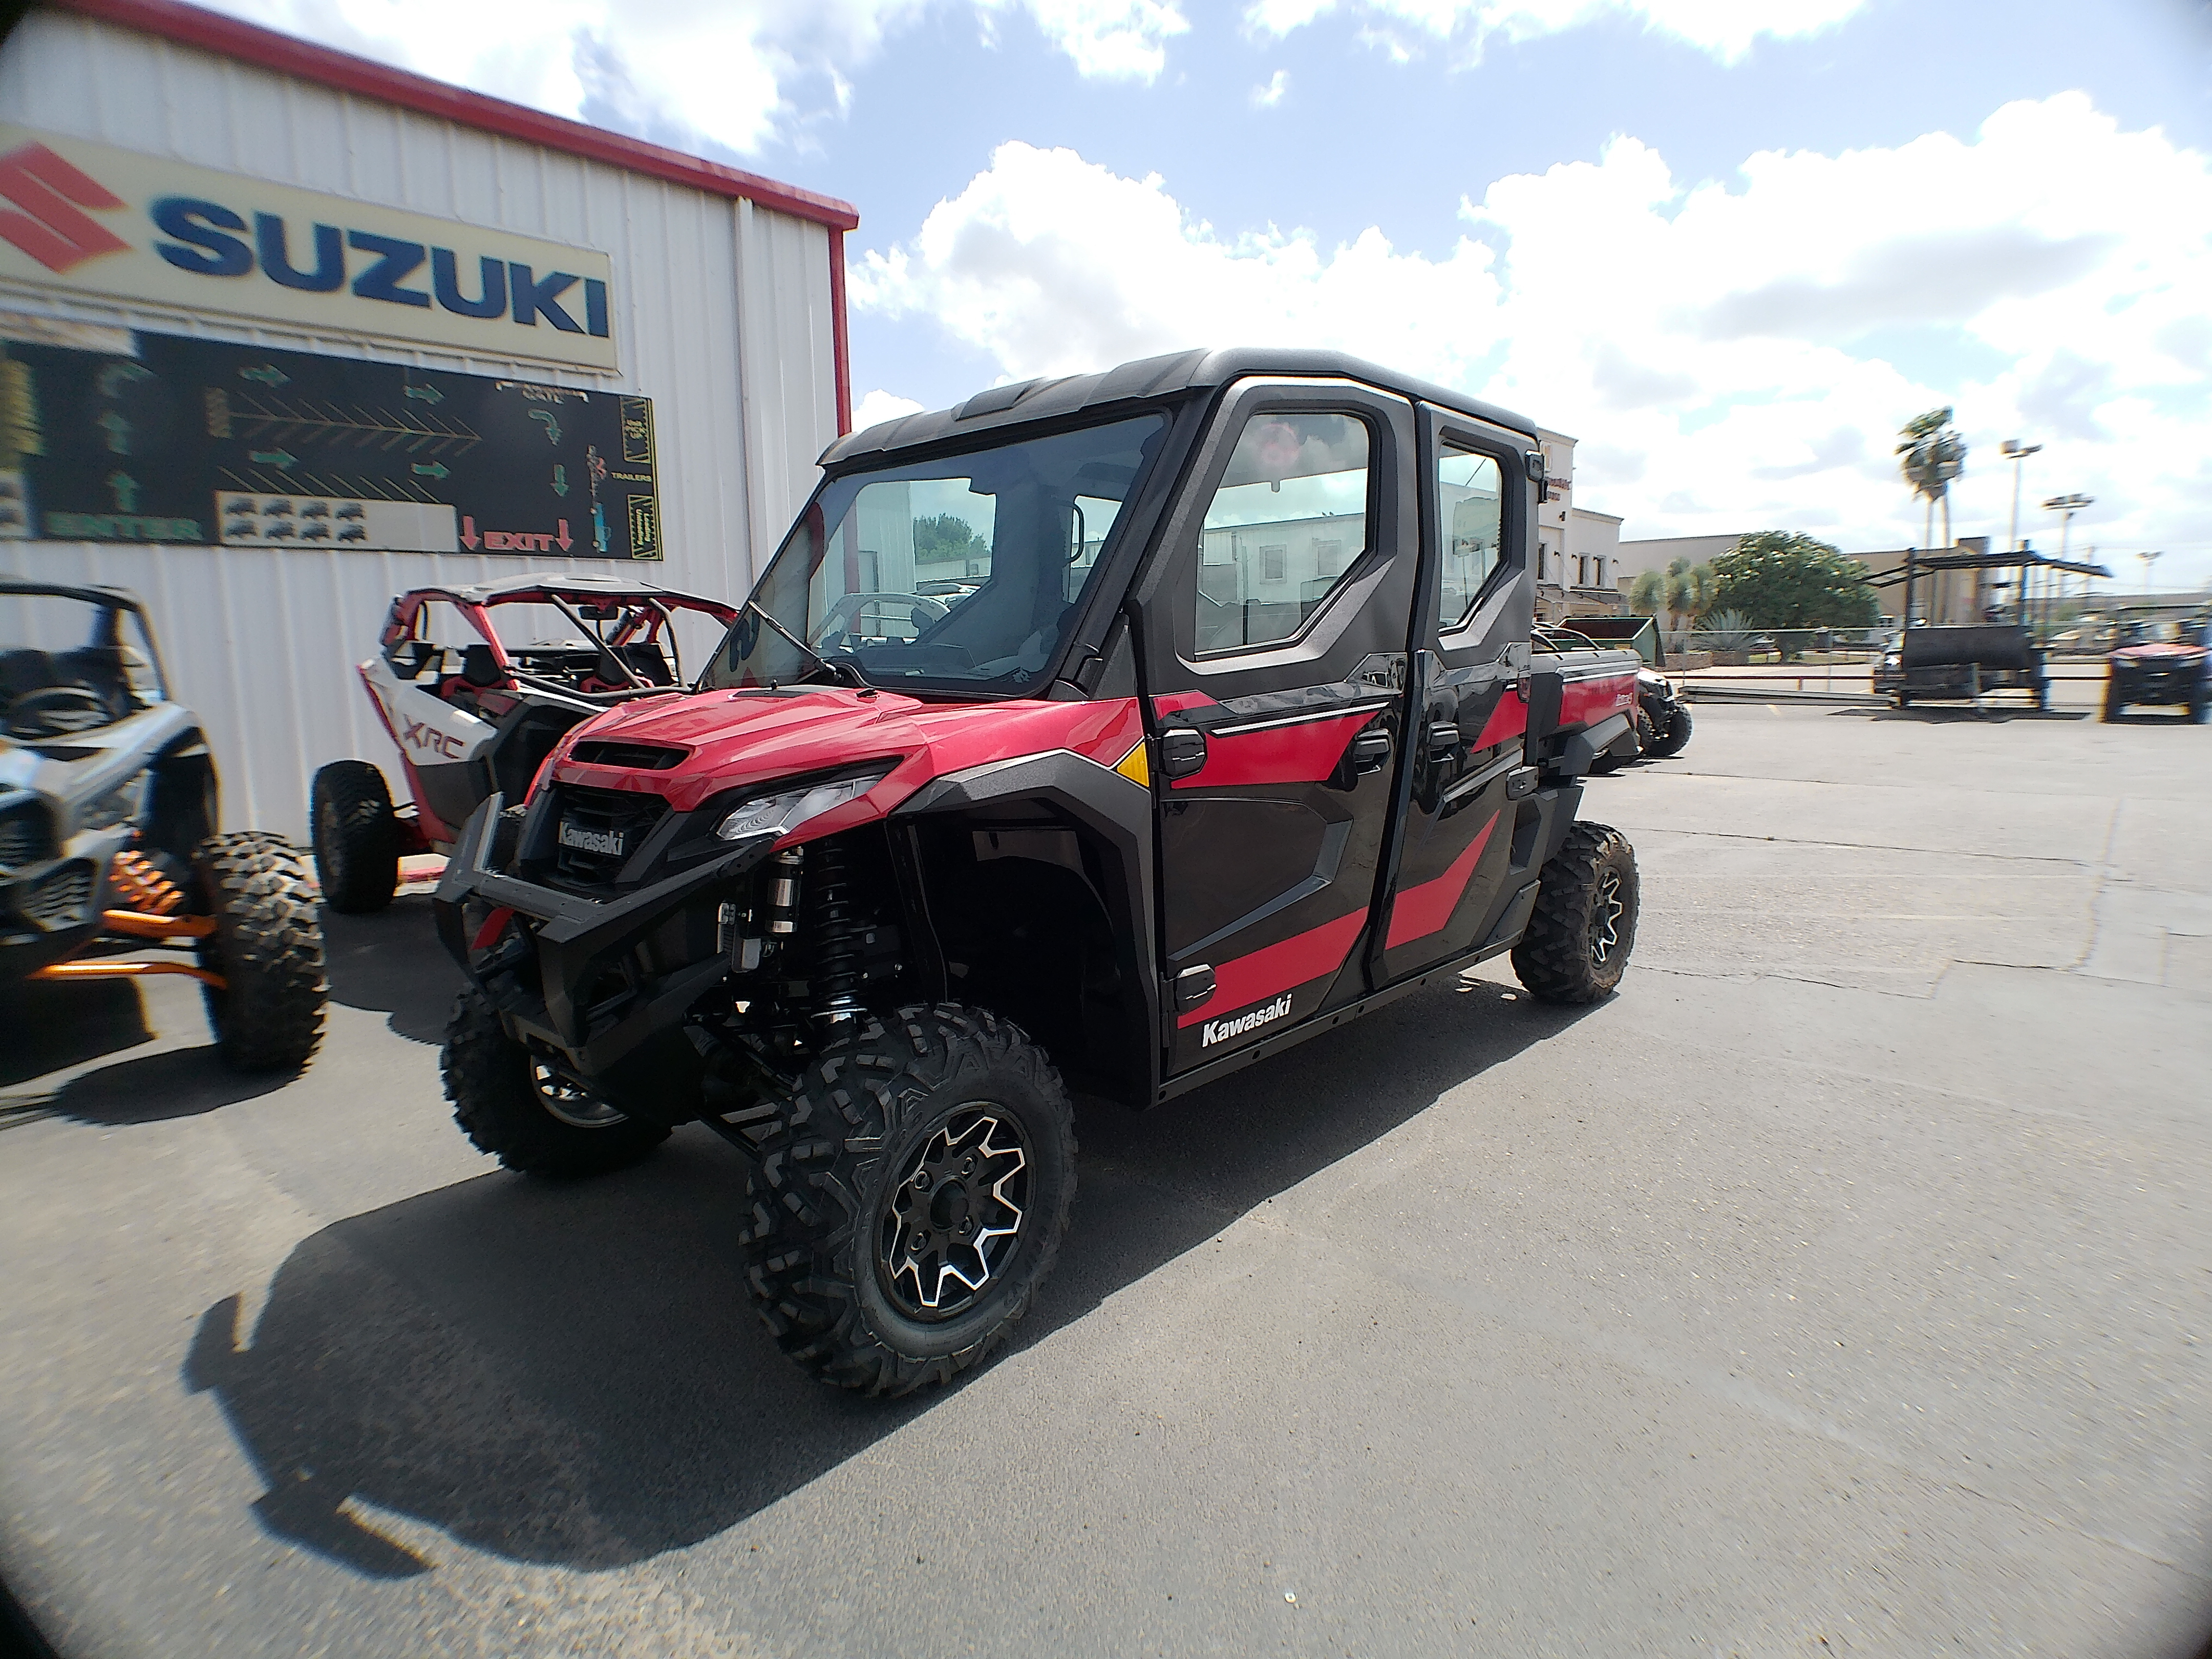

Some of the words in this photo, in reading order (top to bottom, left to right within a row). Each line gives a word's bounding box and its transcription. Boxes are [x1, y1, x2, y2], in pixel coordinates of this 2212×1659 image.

[149, 192, 609, 338] SUZUKI
[611, 472, 652, 482] TRAILERS
[45, 512, 203, 540] ENTER
[483, 531, 555, 551] EXIT
[403, 713, 463, 759] XRC
[558, 821, 624, 856] Kawasaki
[1202, 993, 1292, 1048] Kawasaki
